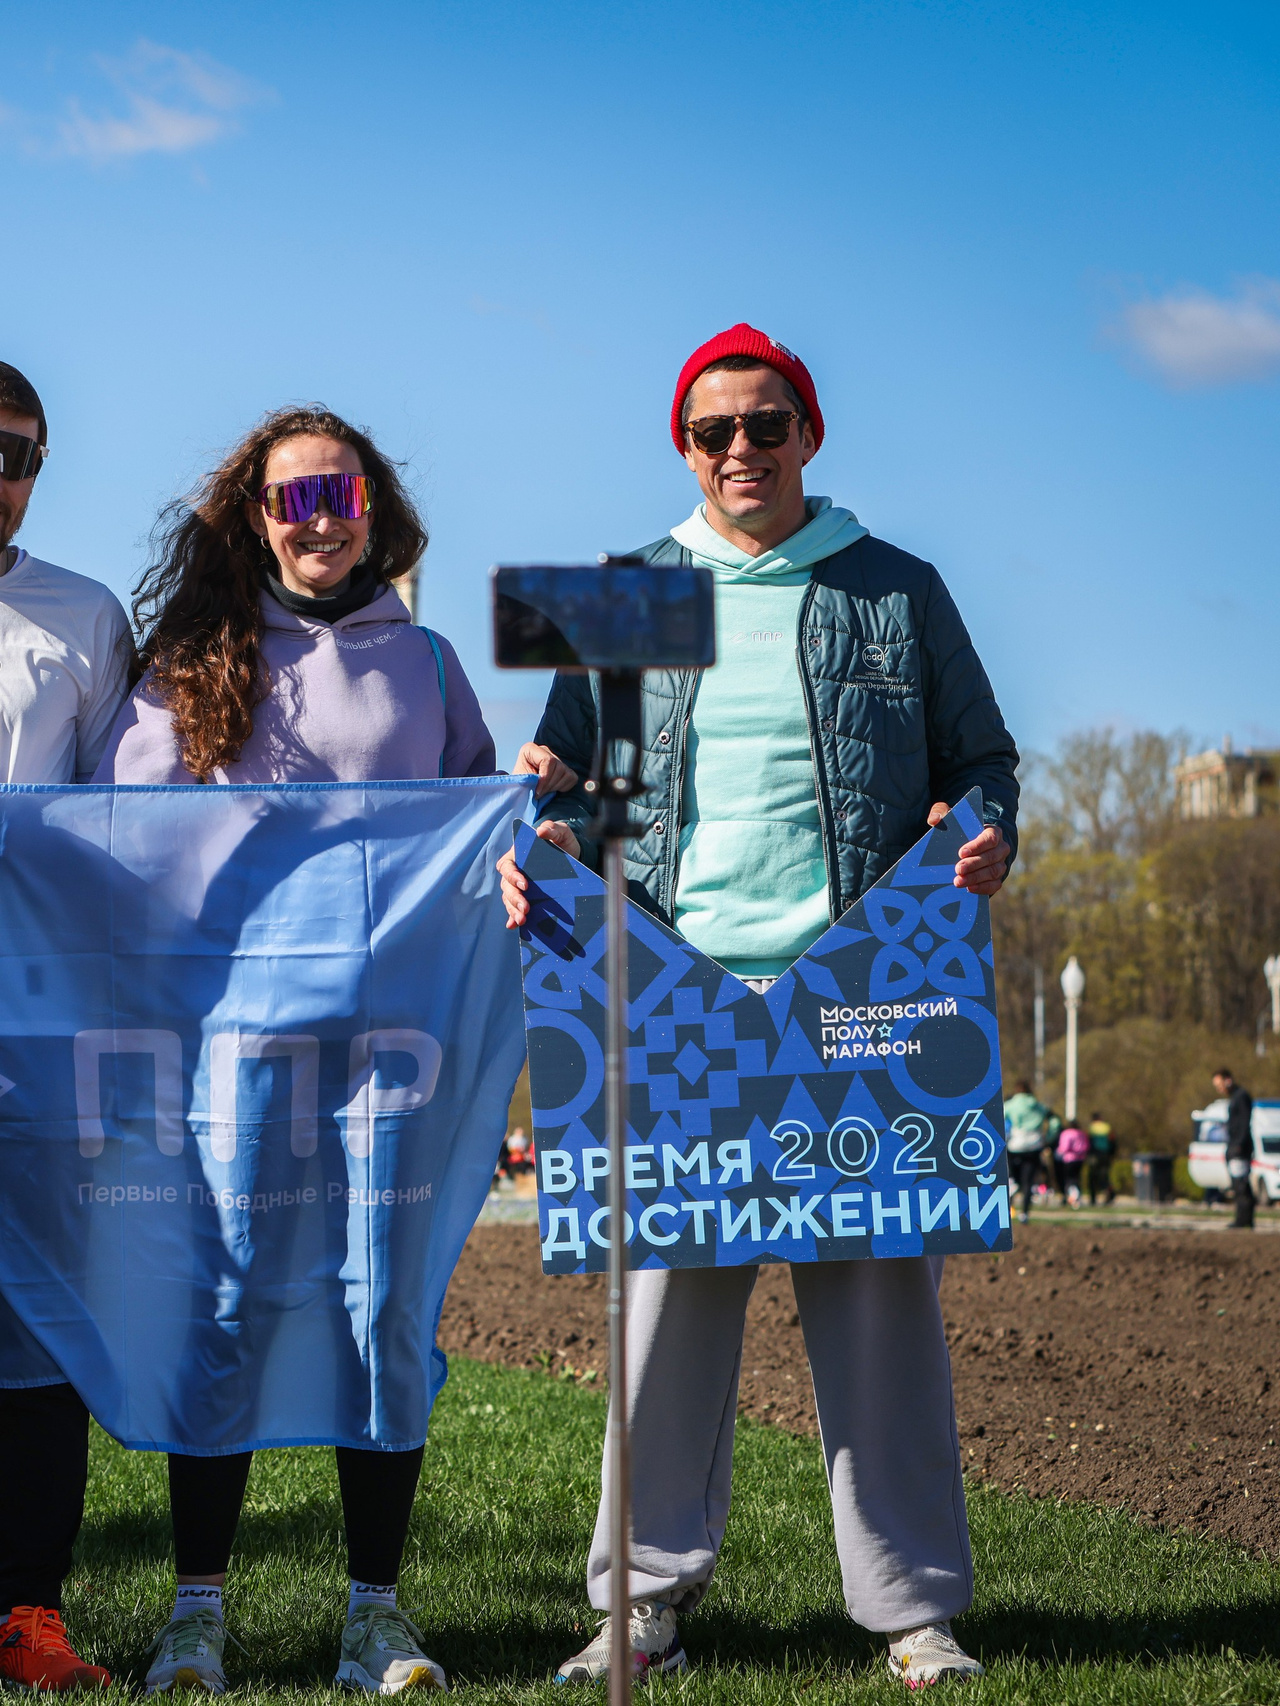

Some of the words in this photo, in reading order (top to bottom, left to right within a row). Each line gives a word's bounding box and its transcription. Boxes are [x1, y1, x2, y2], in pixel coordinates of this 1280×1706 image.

[336, 639, 374, 650] БОЛЬШЕ
[751, 631, 783, 641] ППР
[820, 997, 958, 1024] МОСКОВСКИЙ
[821, 1024, 877, 1042] ПОЛУ
[822, 1040, 922, 1060] МАРАФОН
[73, 1028, 443, 1163] ППР
[540, 1139, 753, 1194] ВРЕМЯ
[769, 1109, 997, 1182] 2026
[78, 1181, 178, 1207] Первые
[187, 1182, 317, 1214] Победные
[327, 1181, 432, 1207] Решения
[541, 1173, 1011, 1261] ДОСТИЖЕНИЙ
